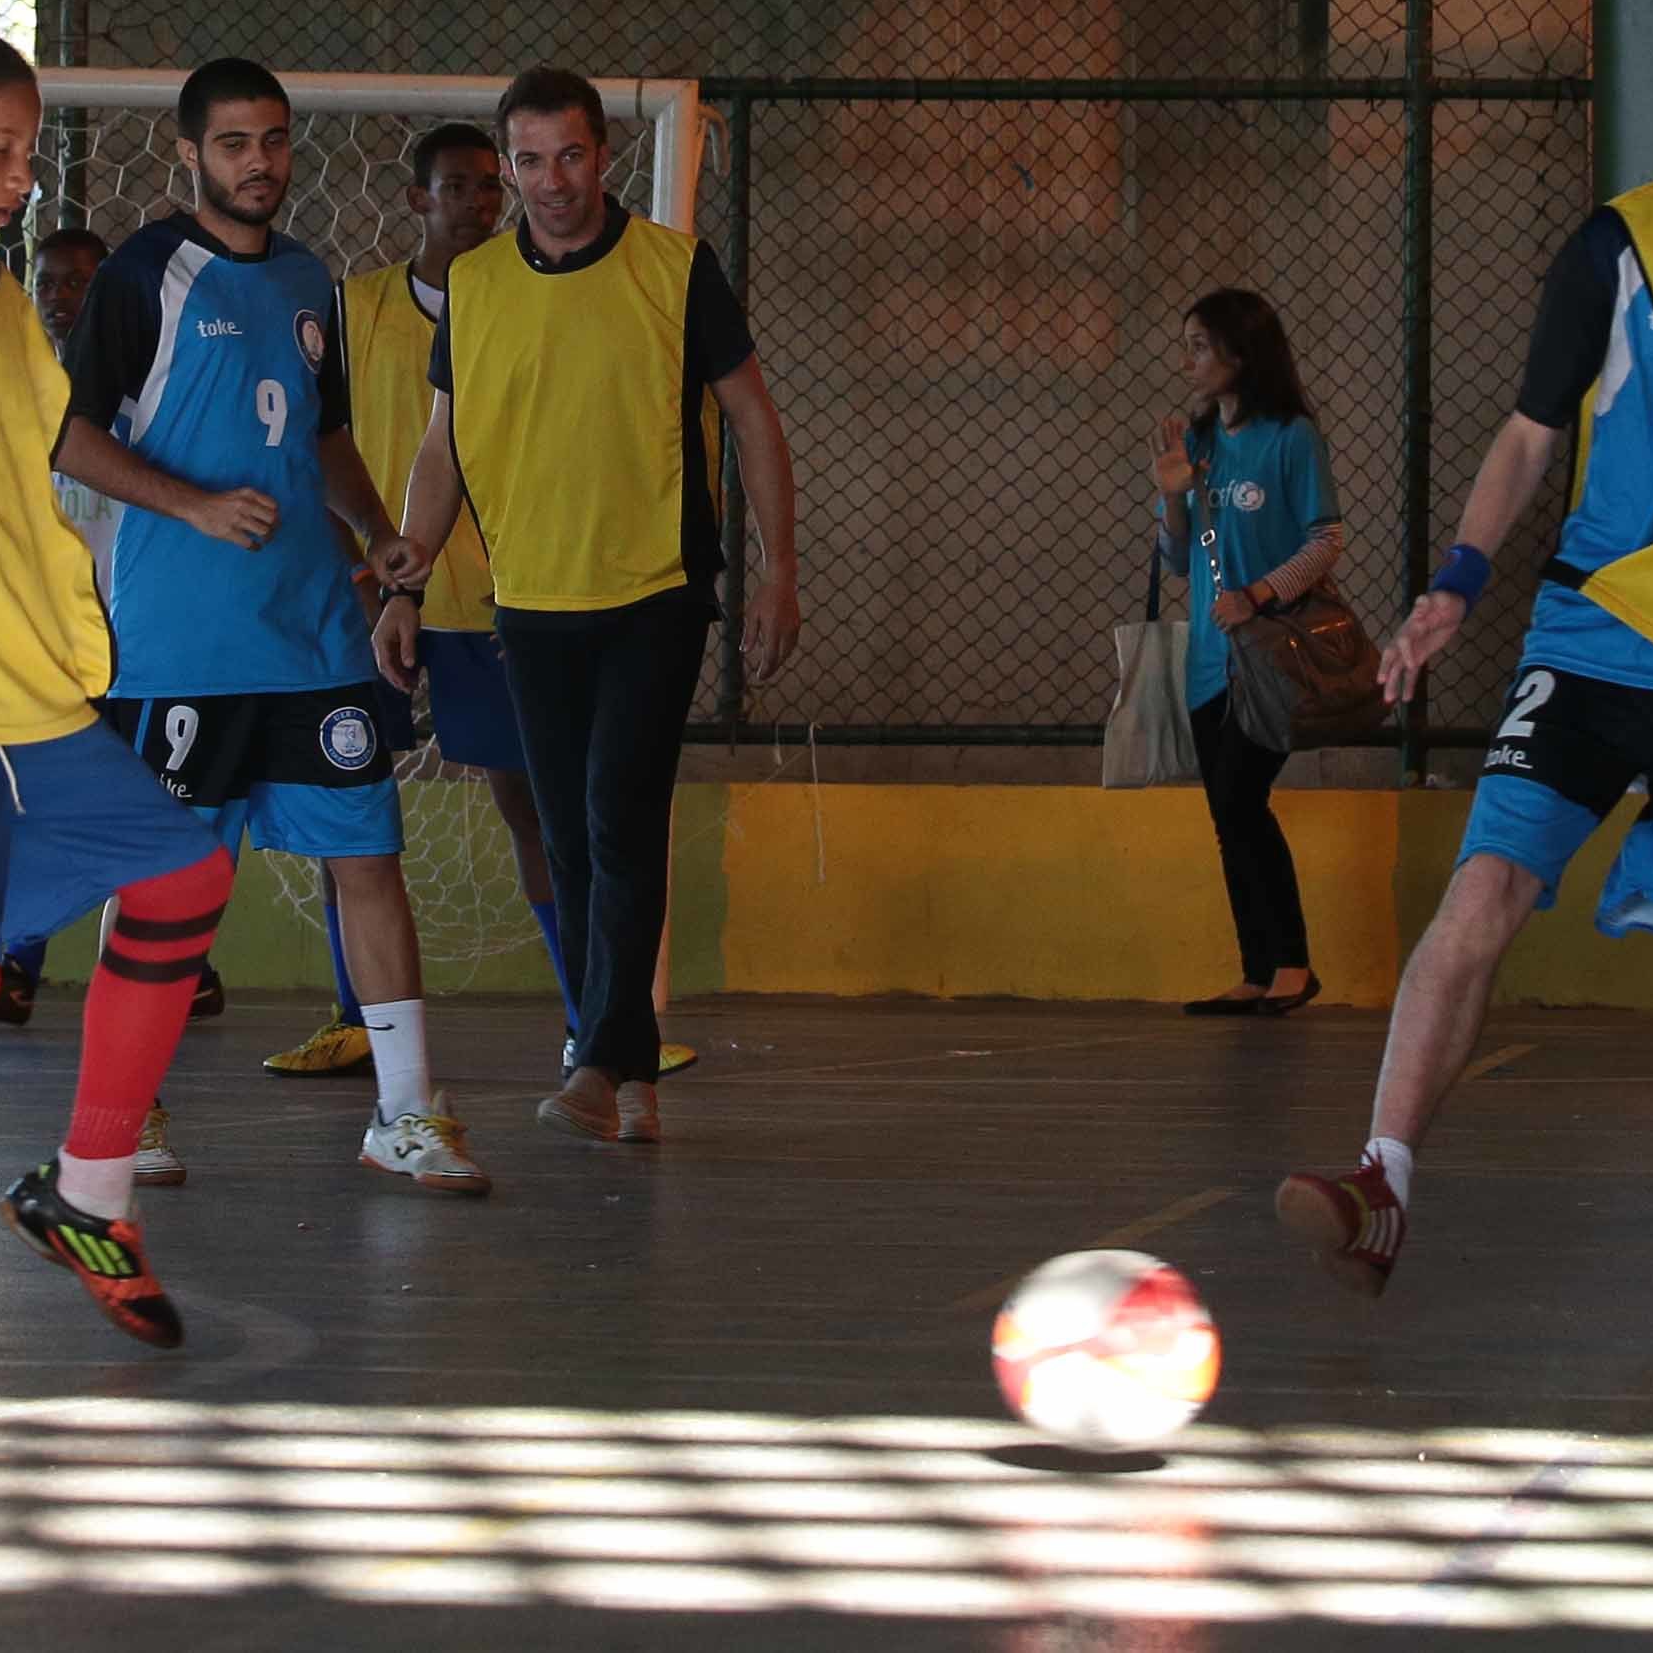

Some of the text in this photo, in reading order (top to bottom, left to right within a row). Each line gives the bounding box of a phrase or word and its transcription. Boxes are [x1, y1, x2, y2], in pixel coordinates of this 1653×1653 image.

[196, 317, 243, 340] toke
[255, 378, 288, 447] 9
[1496, 670, 1557, 738] 2
[165, 705, 199, 772] 9
